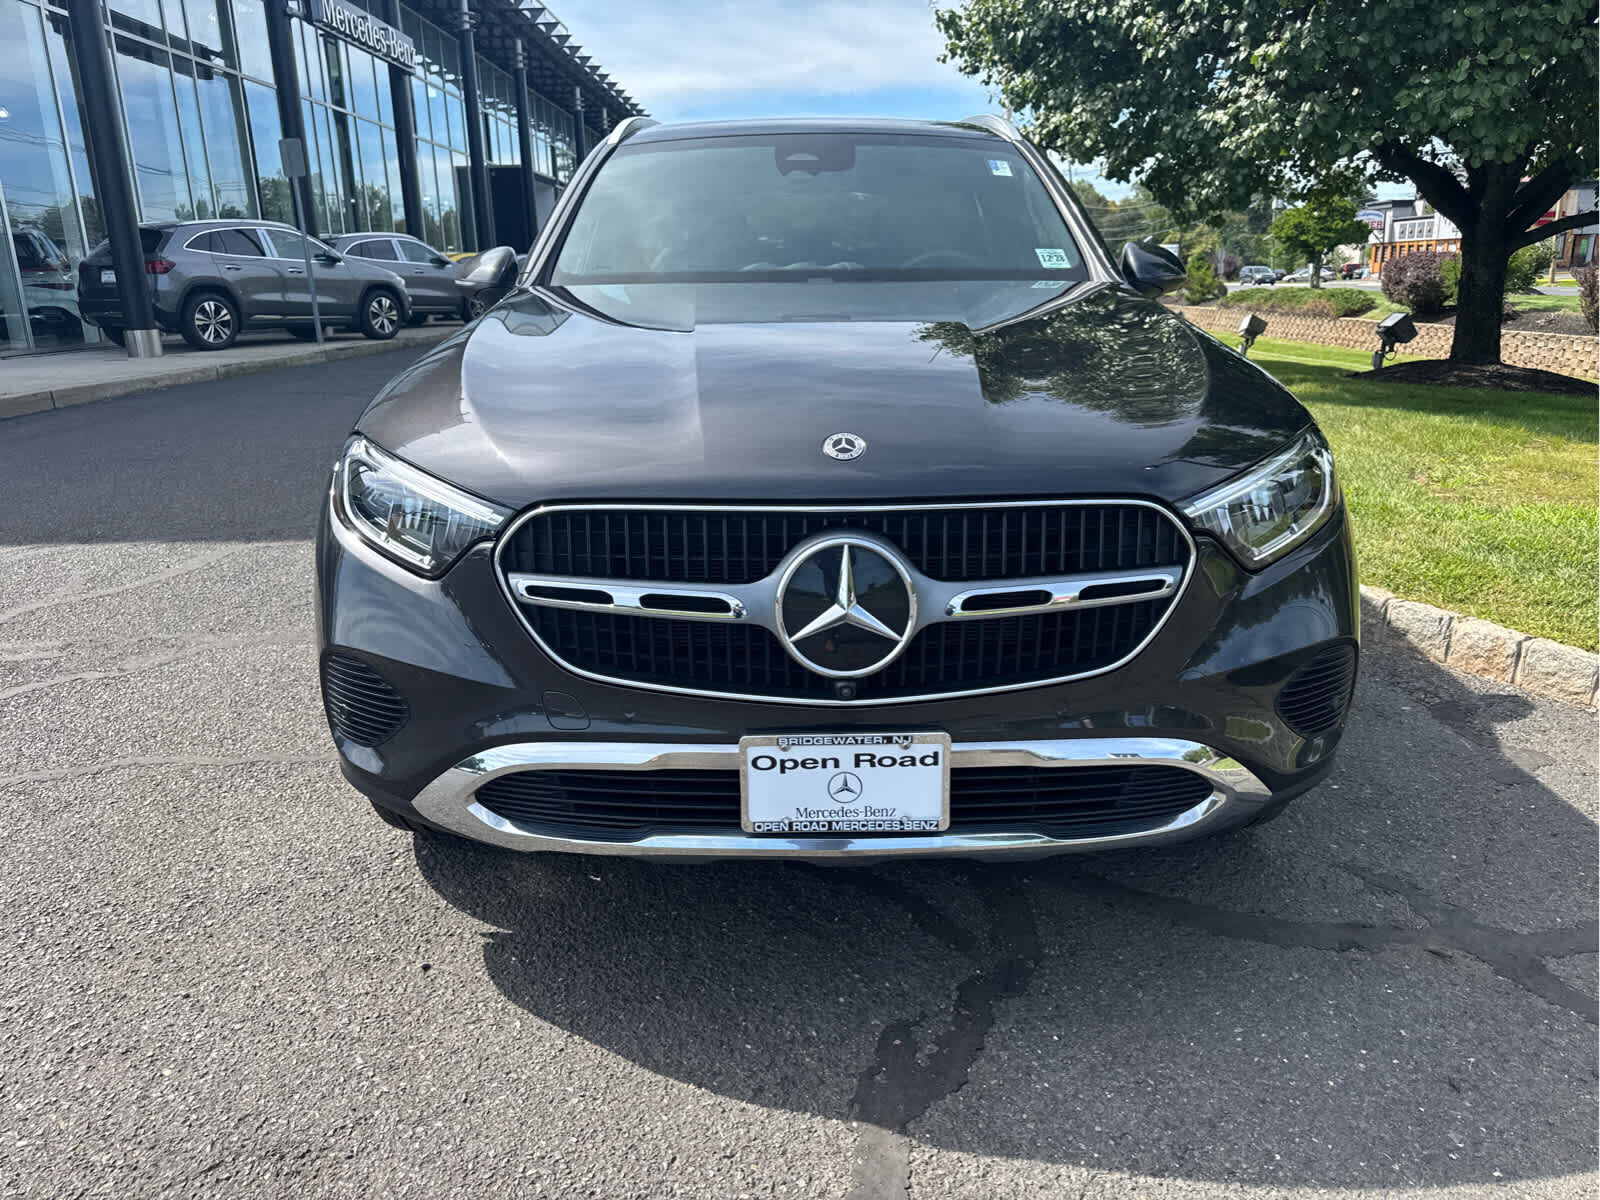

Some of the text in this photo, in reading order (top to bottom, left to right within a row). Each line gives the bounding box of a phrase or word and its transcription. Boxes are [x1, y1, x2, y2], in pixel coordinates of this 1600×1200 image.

[322, 0, 416, 66] Mercedes-Benz
[778, 735, 913, 745] BRIDGEWATER, NJ
[751, 751, 939, 774] Open Road
[795, 805, 897, 819] Mercedes-Benz
[754, 819, 938, 832] OPEN ROAD MERCEDES-BENZ
